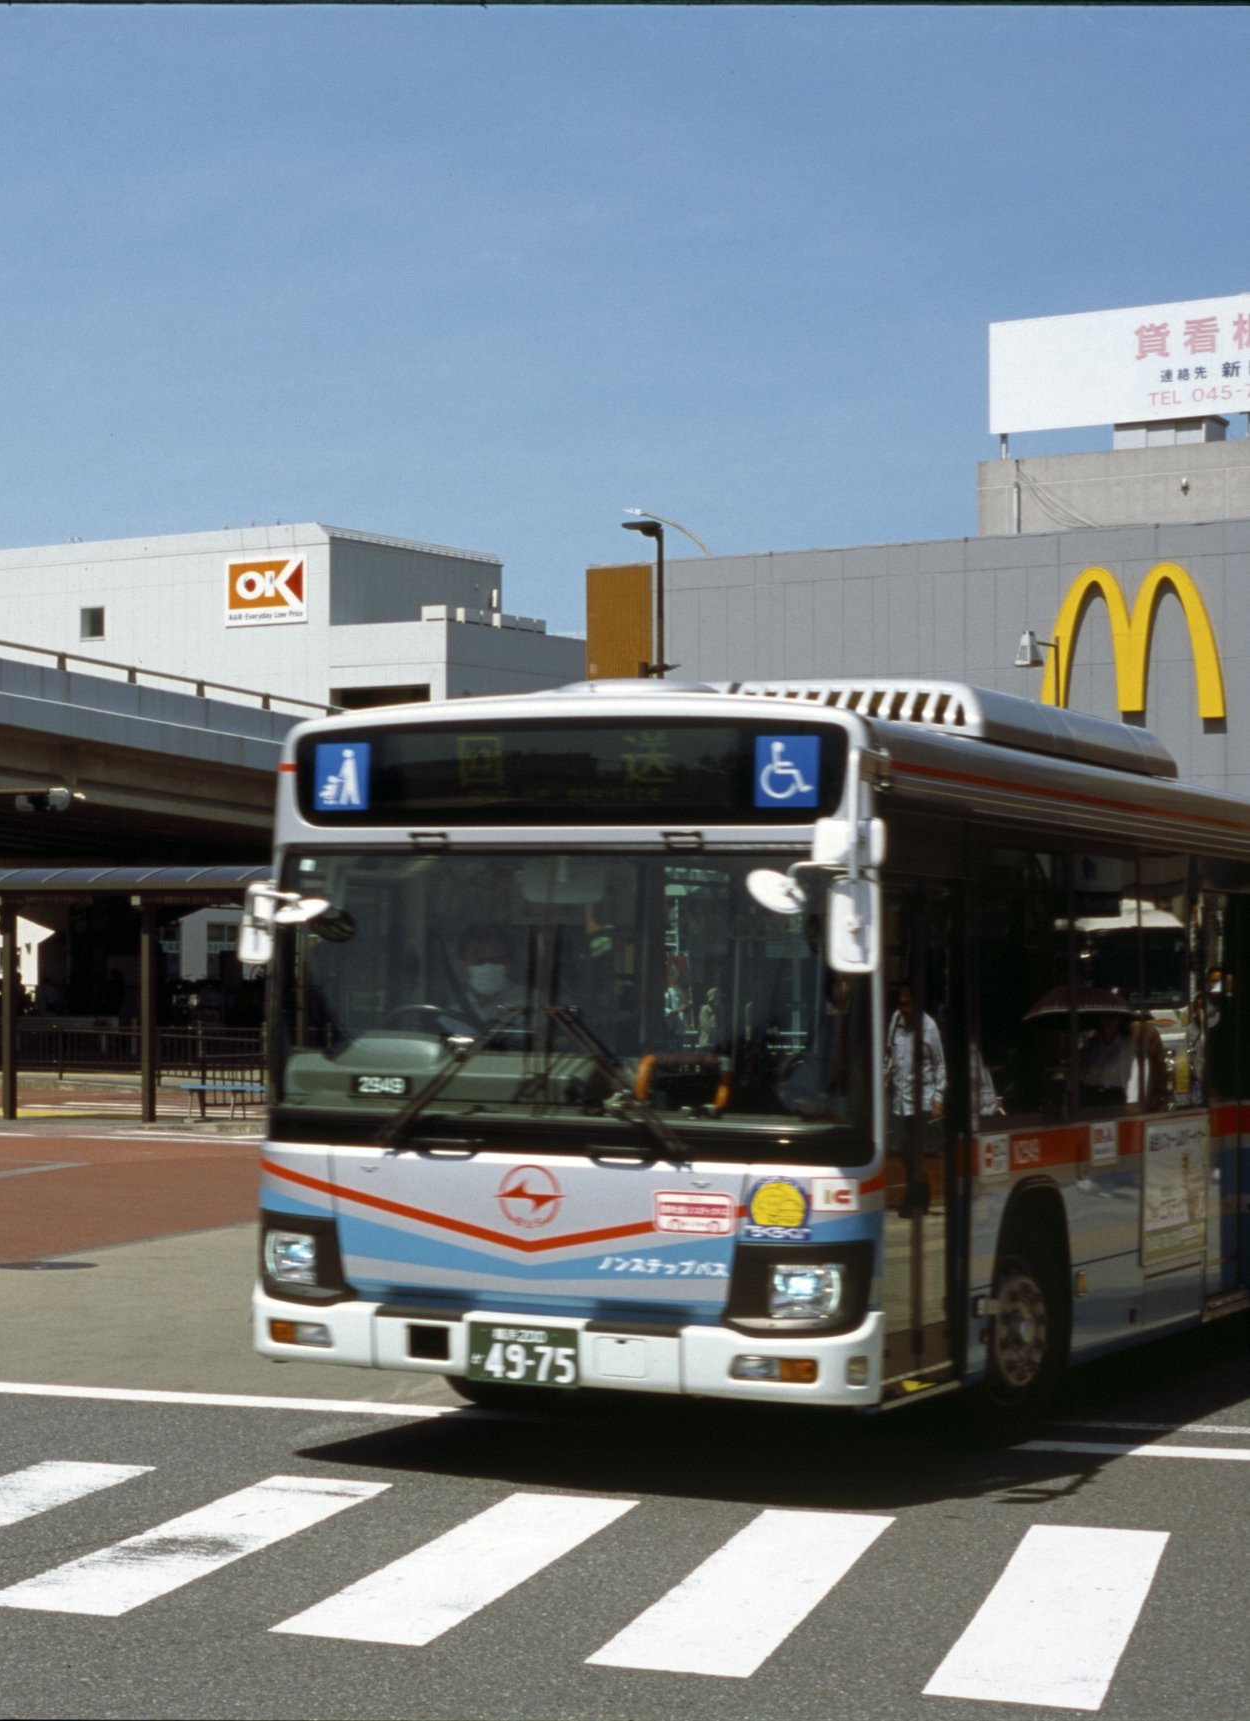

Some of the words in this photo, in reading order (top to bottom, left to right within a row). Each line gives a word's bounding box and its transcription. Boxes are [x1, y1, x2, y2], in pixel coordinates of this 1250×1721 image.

[1160, 366, 1209, 383] 連絡先
[1148, 390, 1183, 407] TEL
[235, 560, 303, 606] OK
[598, 1256, 730, 1278] ノンステップバス
[484, 1343, 577, 1384] 49-75
